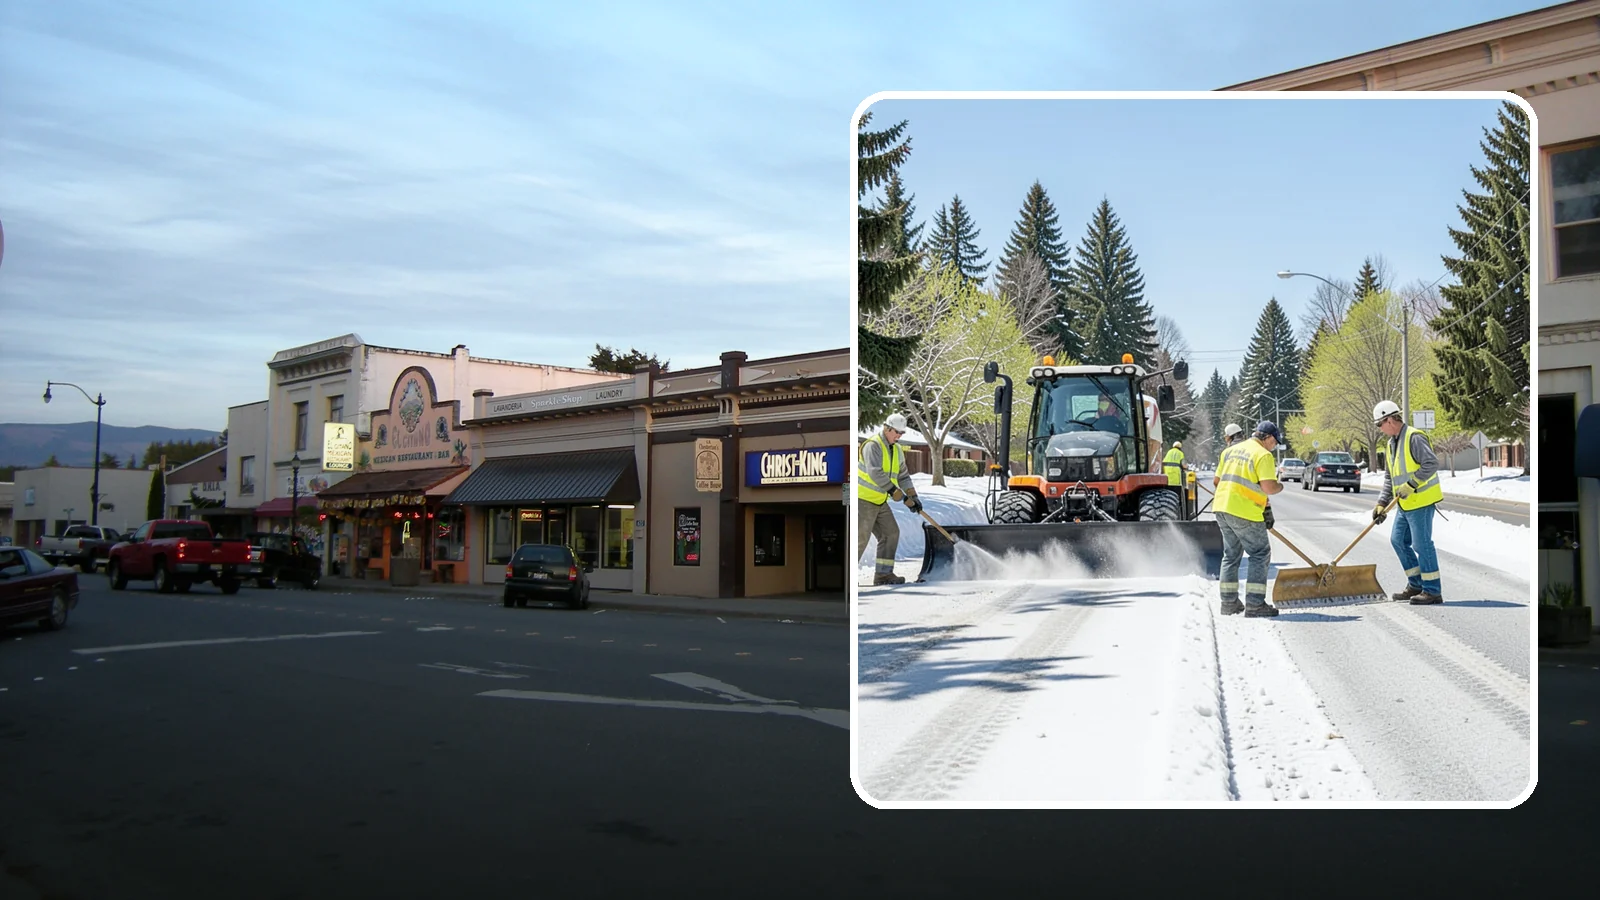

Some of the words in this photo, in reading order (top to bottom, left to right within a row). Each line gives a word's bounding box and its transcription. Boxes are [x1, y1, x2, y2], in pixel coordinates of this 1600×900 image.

[530, 397, 561, 409] Sparkle
[561, 393, 583, 405] Shop
[595, 388, 624, 400] LAUNDRY
[493, 402, 523, 413] LAVANDERIA
[373, 454, 396, 464] MEXICAN
[397, 451, 433, 463] RESTAURANT
[437, 450, 450, 459] BAR
[760, 452, 797, 478] CHRIST
[799, 450, 827, 476] KING
